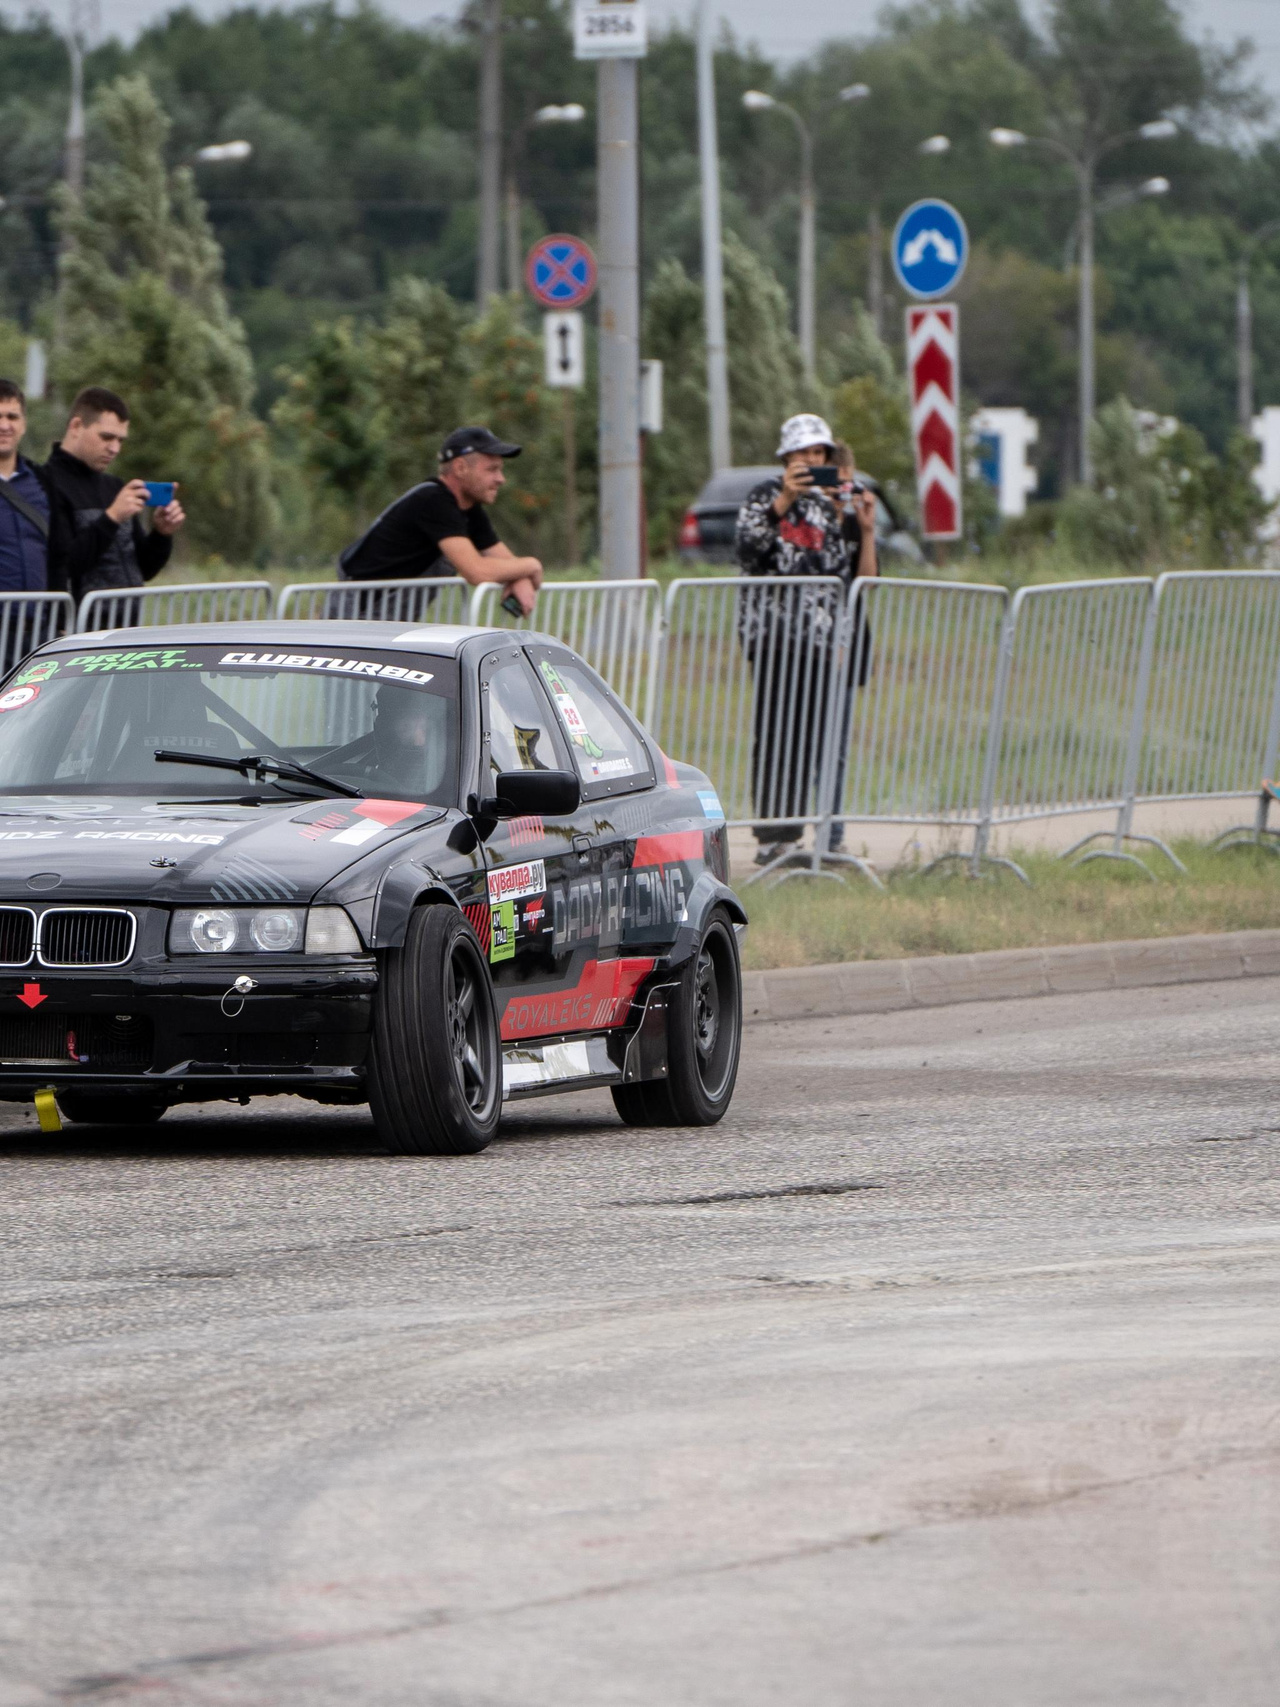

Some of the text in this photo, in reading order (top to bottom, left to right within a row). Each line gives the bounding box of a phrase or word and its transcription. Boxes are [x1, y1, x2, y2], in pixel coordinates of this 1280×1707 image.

[65, 650, 187, 667] DRIFT
[82, 658, 204, 673] THAT...
[218, 652, 435, 685] CLUBTURBO
[5, 694, 26, 703] 33
[563, 708, 580, 725] 33
[143, 735, 218, 748] BRIDE
[74, 831, 224, 845] RACING
[489, 863, 544, 900] кувалда.ру
[553, 867, 687, 945] DADZ RACING
[508, 993, 593, 1030] ROYALEKS
